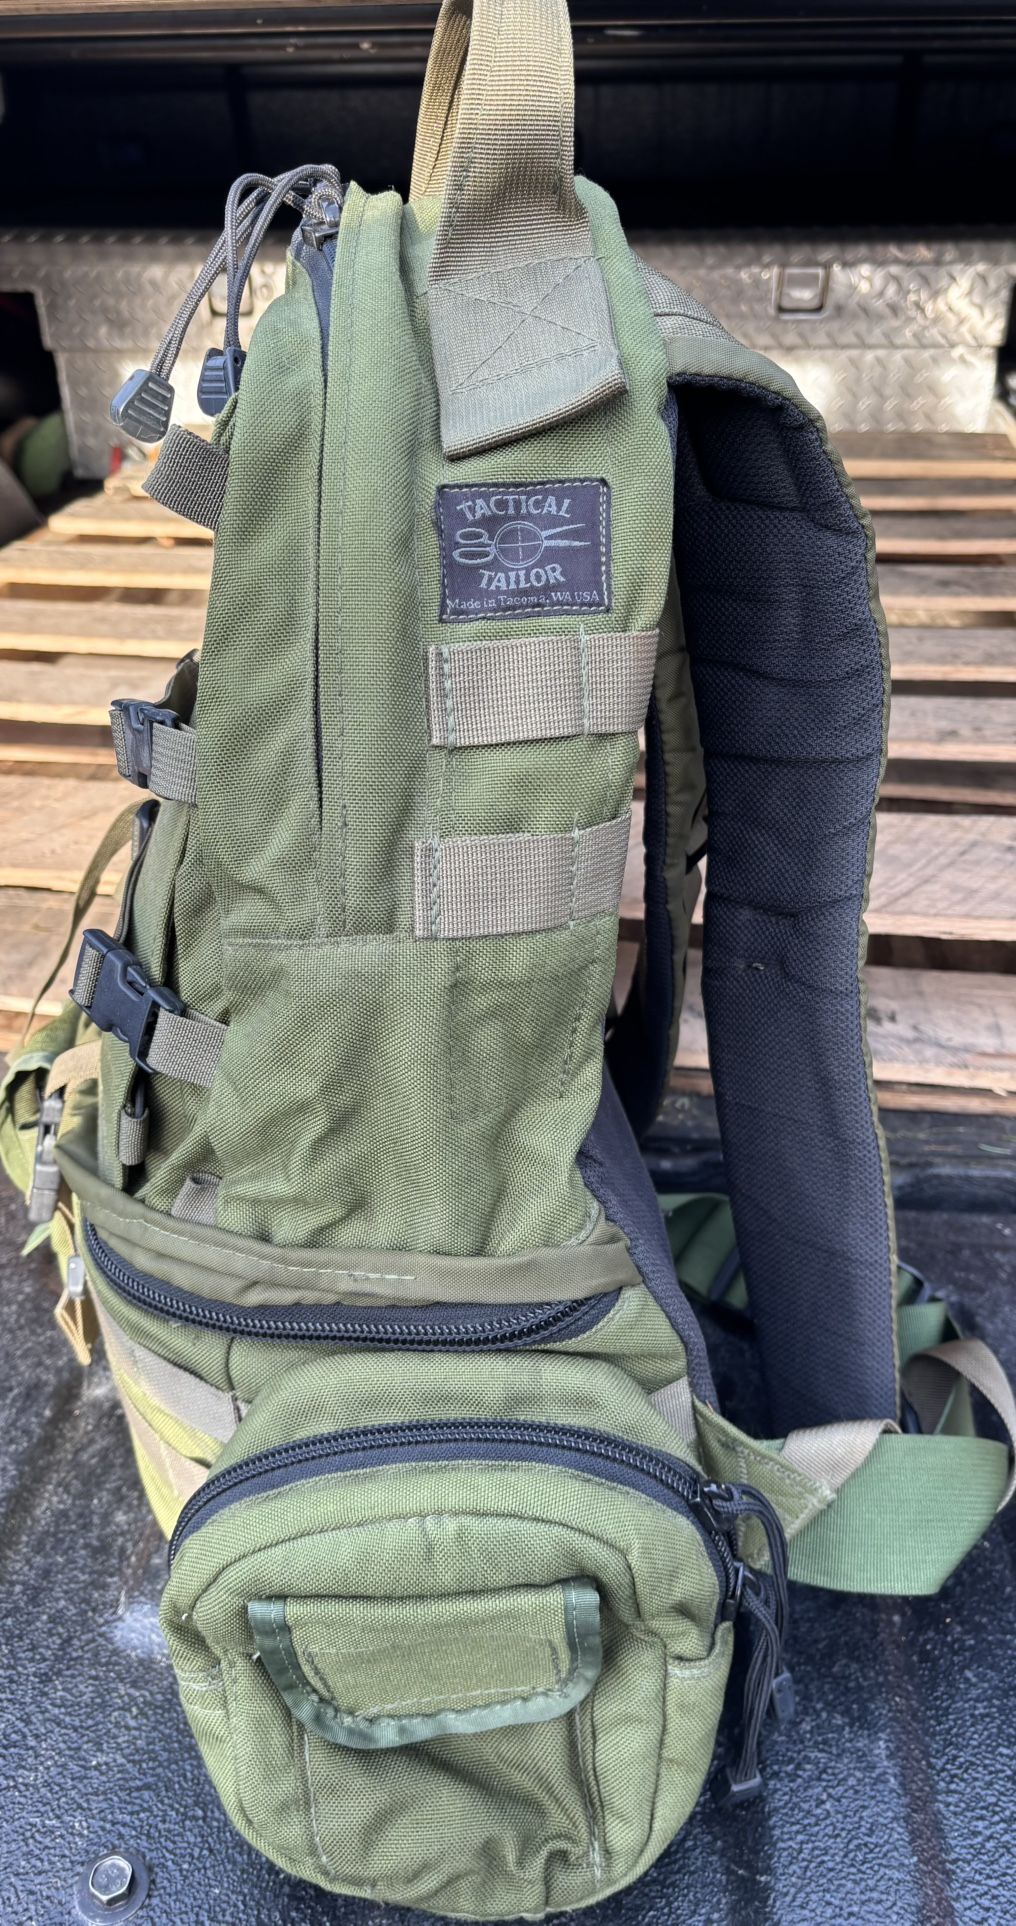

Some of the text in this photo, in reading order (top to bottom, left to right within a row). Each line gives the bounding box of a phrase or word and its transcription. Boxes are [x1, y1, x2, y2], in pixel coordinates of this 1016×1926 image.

[456, 495, 571, 522] TACTICAL
[479, 563, 566, 590] TAILOR
[449, 598, 481, 609] Made
[484, 597, 497, 608] in
[551, 591, 571, 602] WA
[575, 590, 600, 602] USA
